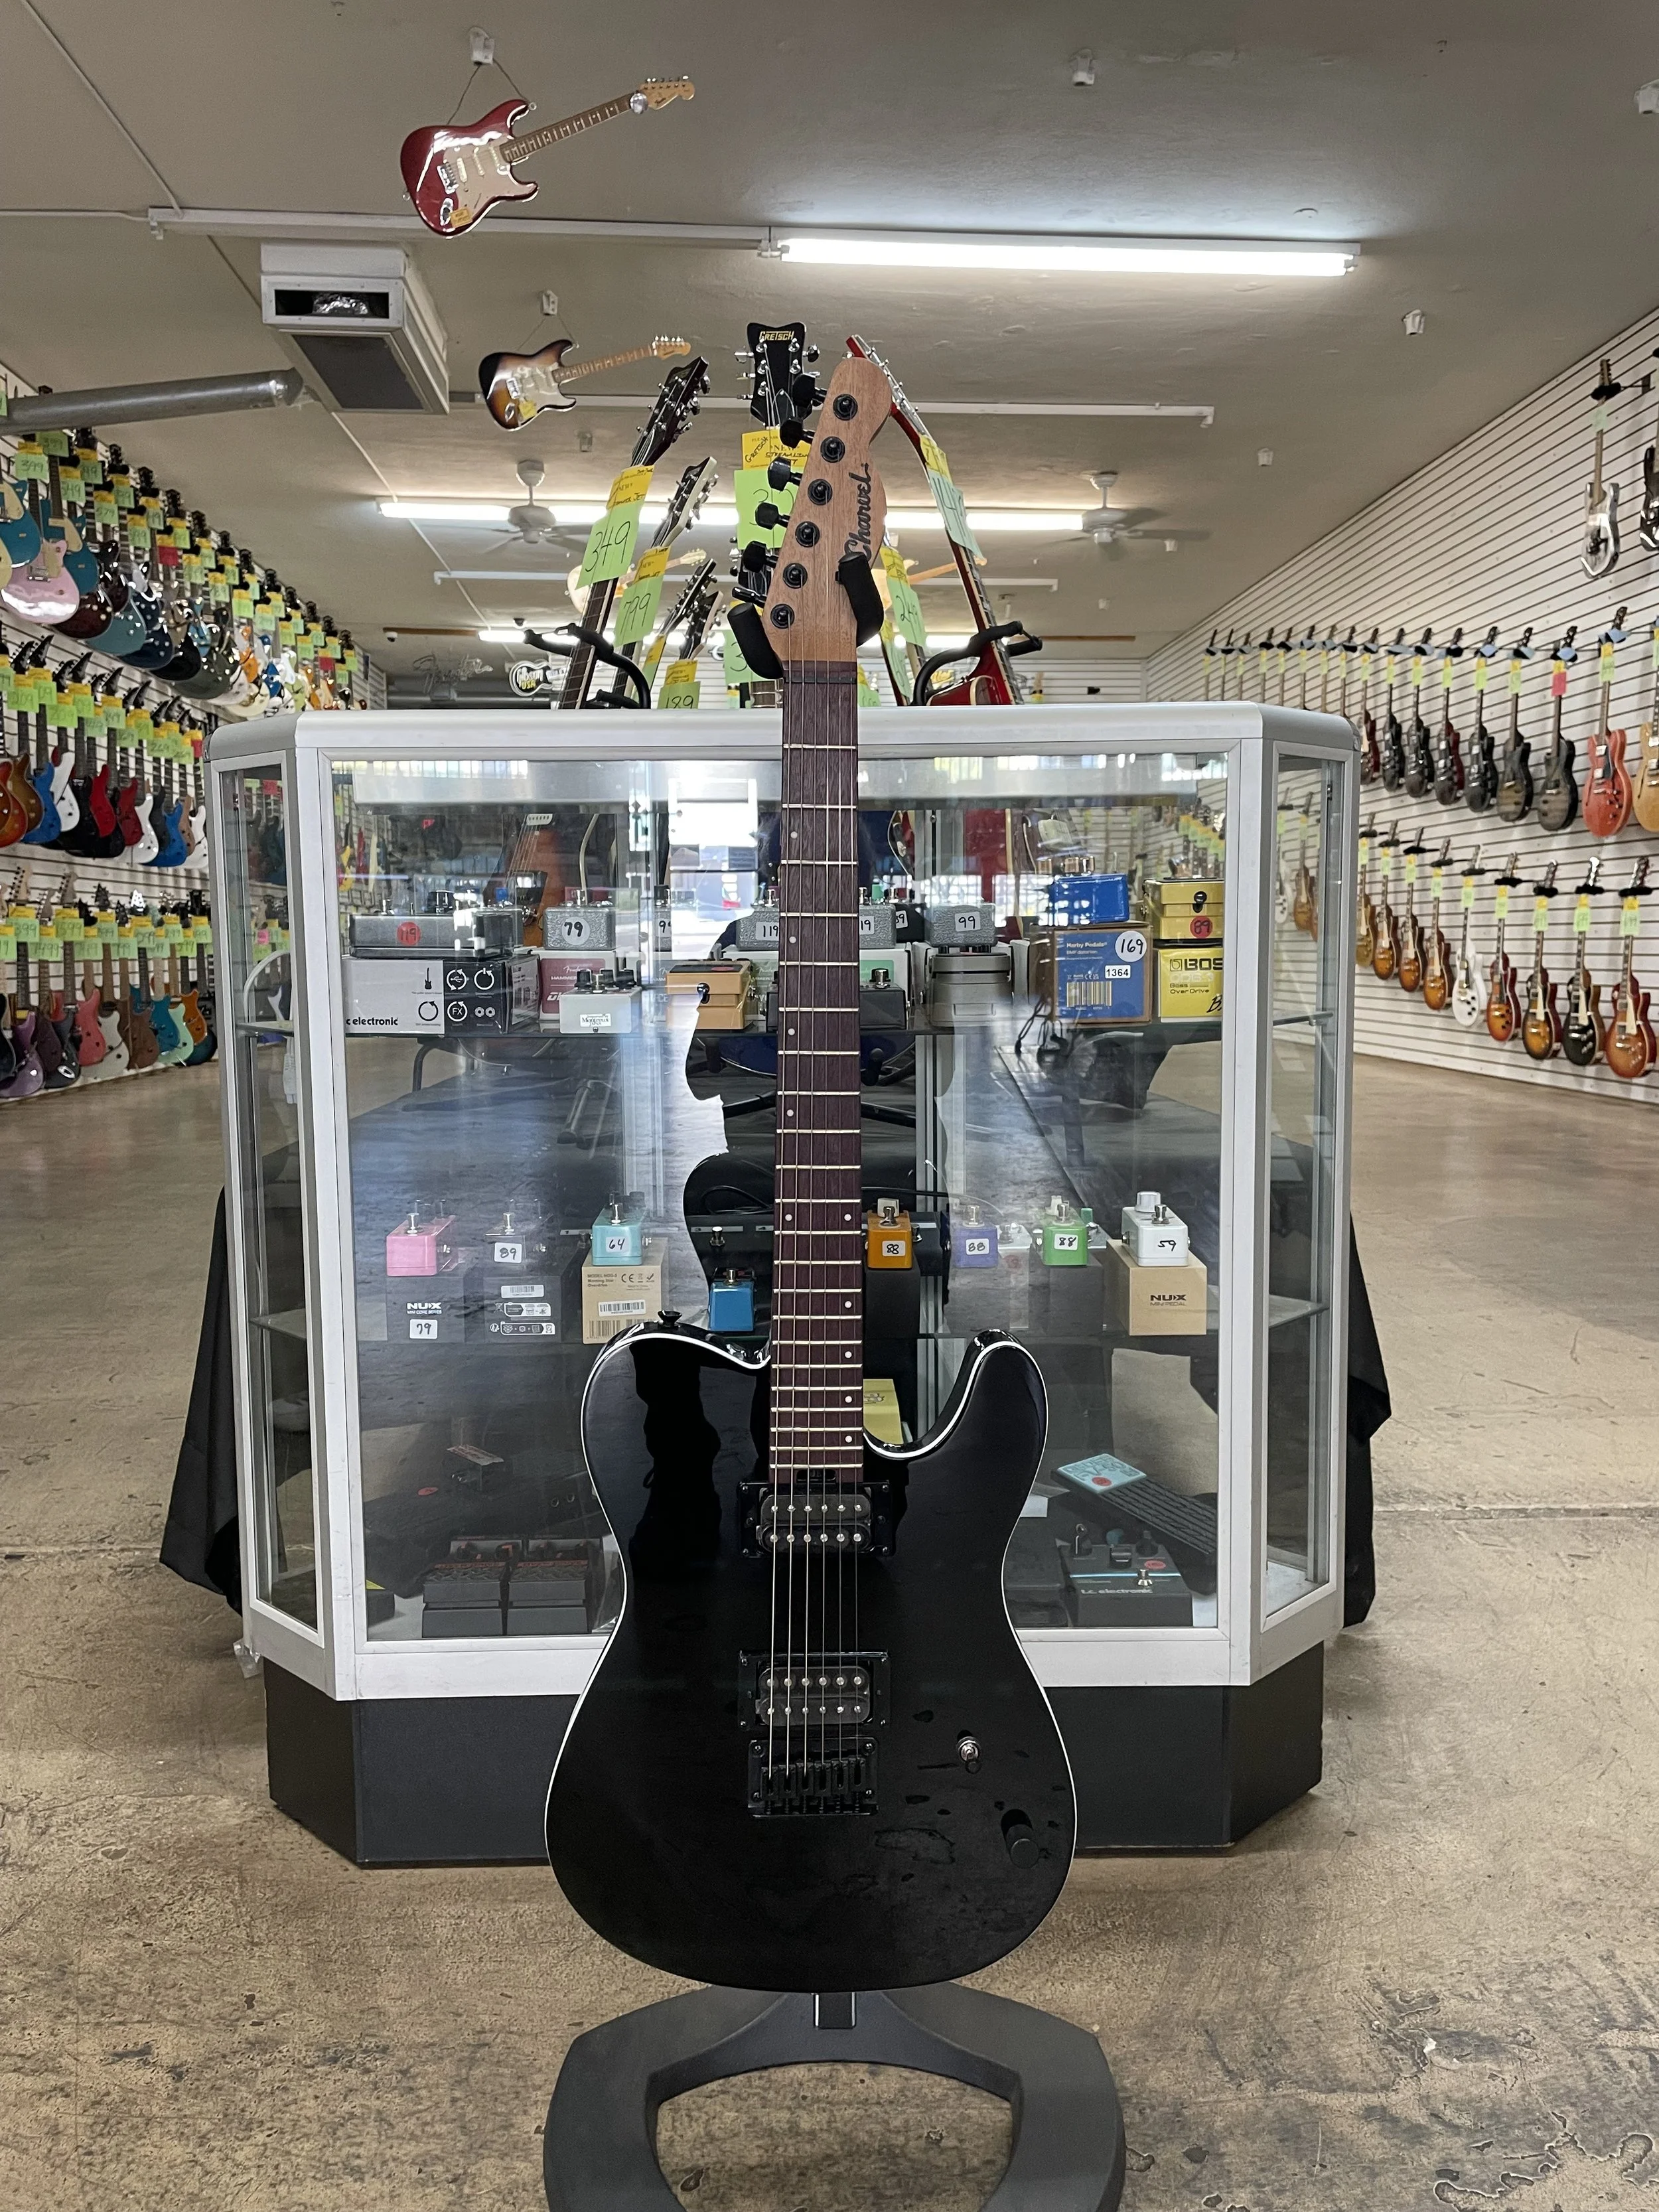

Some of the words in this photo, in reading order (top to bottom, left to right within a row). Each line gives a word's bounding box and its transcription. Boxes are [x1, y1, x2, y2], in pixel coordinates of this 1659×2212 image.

[759, 331, 794, 340] GRETSCH
[844, 463, 872, 561] Charvel
[585, 521, 630, 572] 349
[620, 593, 651, 635] 799
[522, 680, 536, 690] USA
[666, 696, 694, 709] 189
[959, 916, 975, 929] 99
[1194, 920, 1210, 934] 89
[564, 921, 583, 937] 79
[763, 925, 778, 937] 119
[1121, 939, 1143, 954] 169
[1106, 968, 1129, 977] 1364
[352, 1017, 398, 1025] electronic
[609, 1238, 625, 1250] 64
[887, 1244, 899, 1254] 88
[968, 1242, 985, 1252] 88
[1157, 1240, 1177, 1252] 59
[500, 1247, 516, 1260] 89
[417, 1323, 431, 1335] 79
